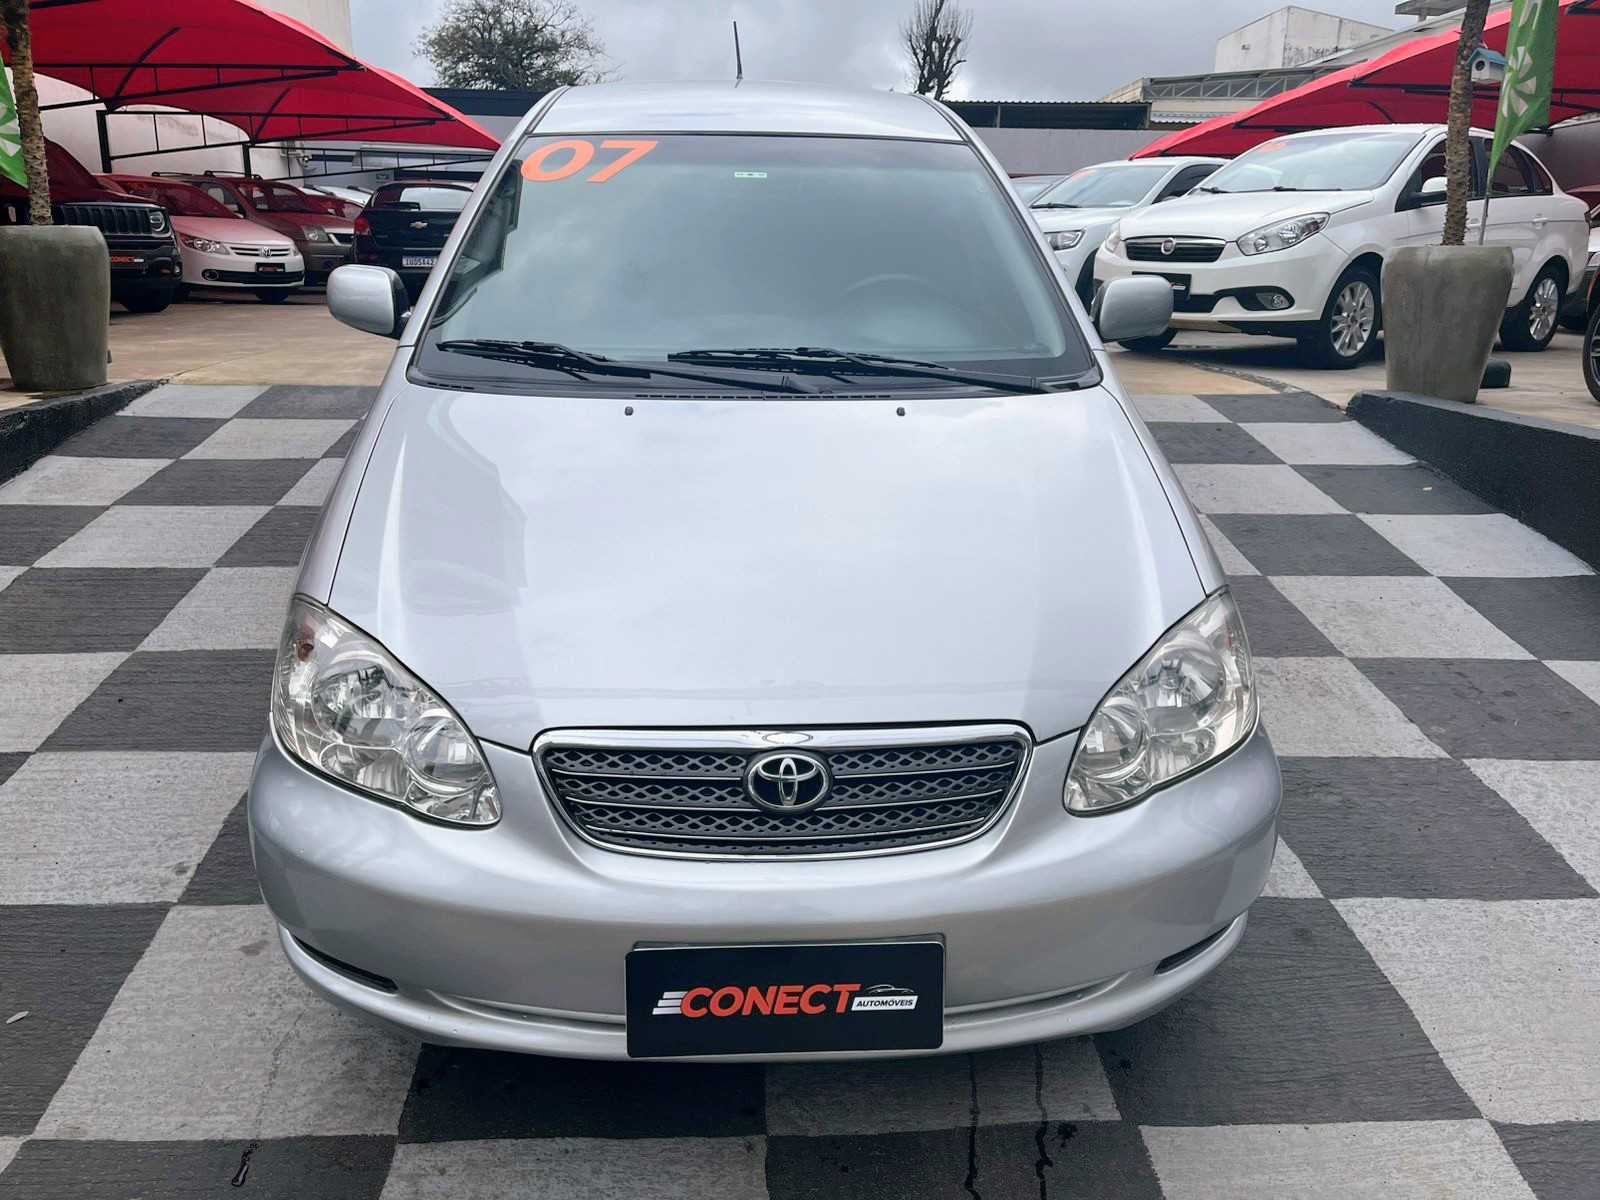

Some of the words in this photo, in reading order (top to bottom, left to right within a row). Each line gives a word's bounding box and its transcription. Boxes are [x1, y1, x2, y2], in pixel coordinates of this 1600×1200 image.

[521, 140, 658, 183] 07
[680, 983, 862, 1018] CONECT
[856, 998, 913, 1008] AUTOMÓVEIS
